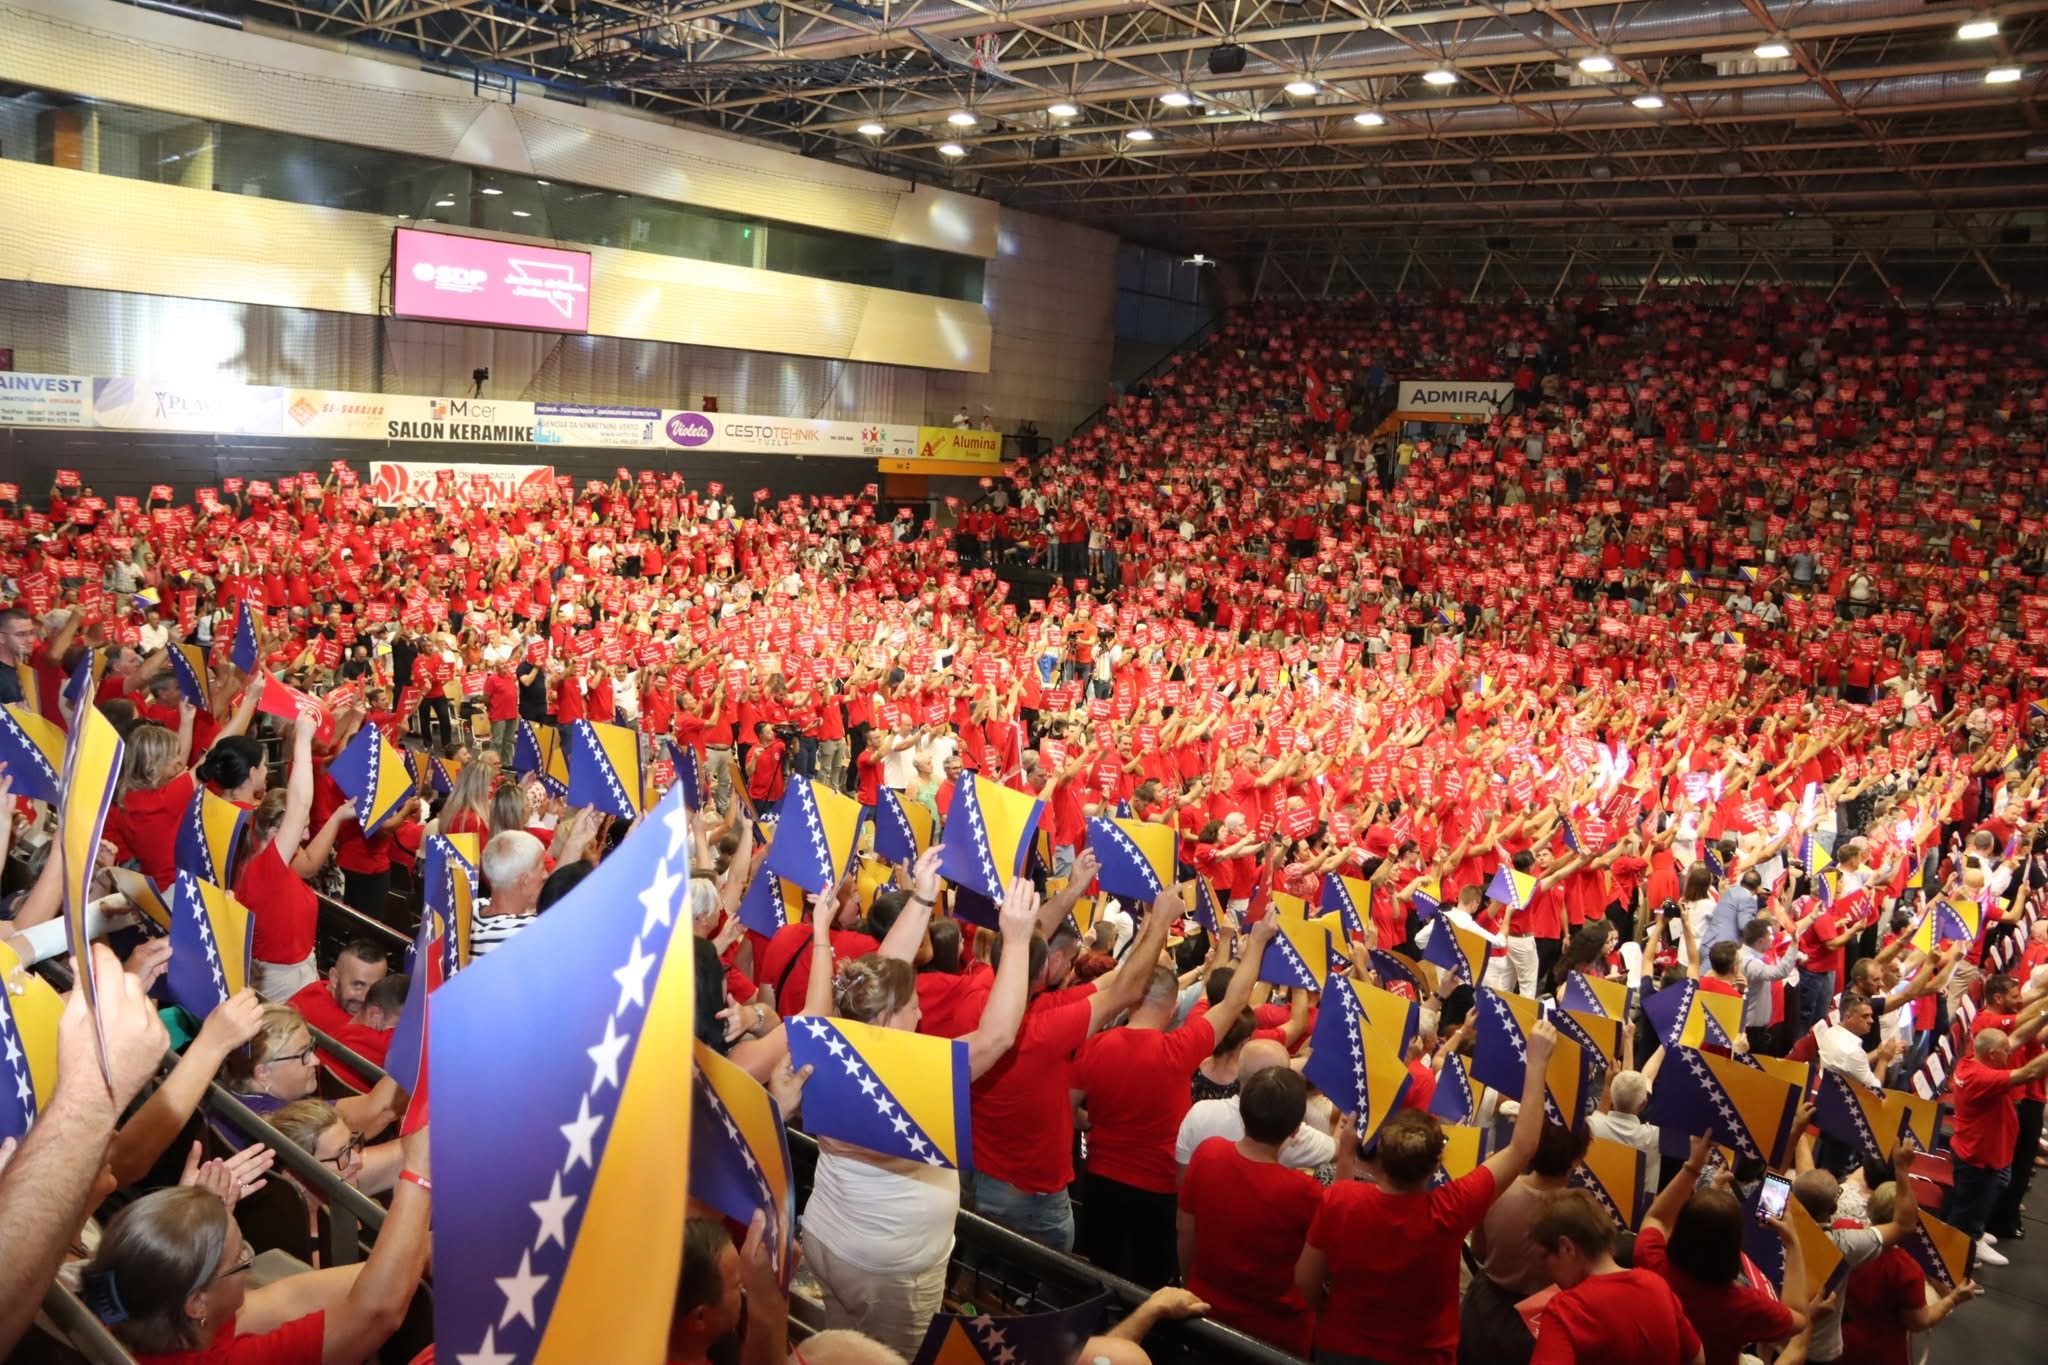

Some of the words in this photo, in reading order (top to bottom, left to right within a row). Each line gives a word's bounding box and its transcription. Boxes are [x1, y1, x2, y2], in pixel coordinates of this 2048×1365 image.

[388, 421, 444, 439] SALON
[450, 424, 534, 442] KERAMIKE
[671, 419, 709, 438] Violeta
[724, 424, 820, 441] CESTOTEHNIK
[953, 435, 996, 450] Alumina
[413, 480, 516, 502] KAKNJ
